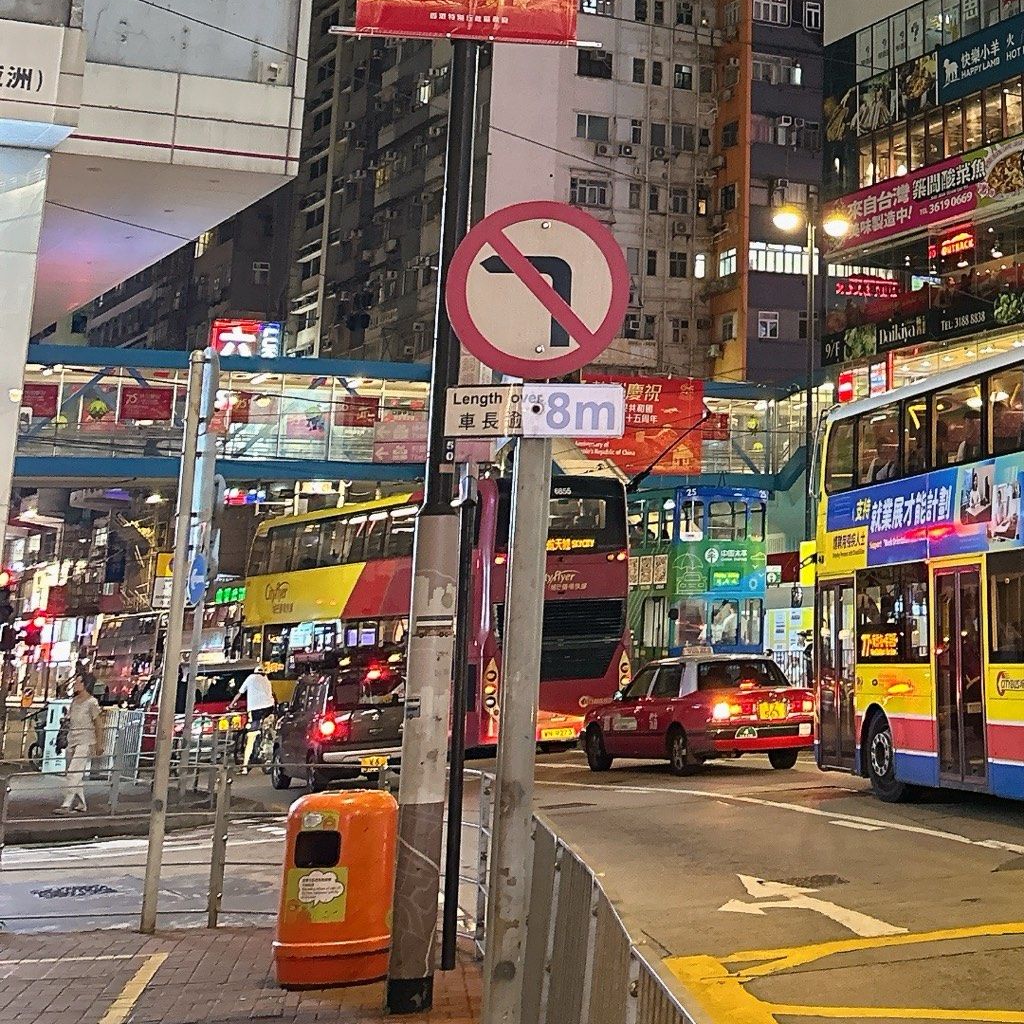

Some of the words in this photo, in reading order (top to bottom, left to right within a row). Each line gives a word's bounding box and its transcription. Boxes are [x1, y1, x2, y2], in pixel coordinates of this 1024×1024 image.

[961, 38, 1000, 69] 快樂小羊
[1006, 47, 1021, 61] HOT
[961, 65, 981, 80] HAPPY
[982, 57, 1001, 71] LAMB
[849, 184, 909, 218] 來自台灣
[929, 199, 950, 214] 3619
[951, 191, 973, 208] 0669
[879, 322, 916, 346] Daikiya
[825, 340, 841, 359] 9/F
[453, 392, 502, 408] Length
[511, 392, 542, 404] over
[546, 391, 616, 431] 8m
[686, 488, 697, 497] 25
[870, 485, 952, 533] 就業展才能計劃
